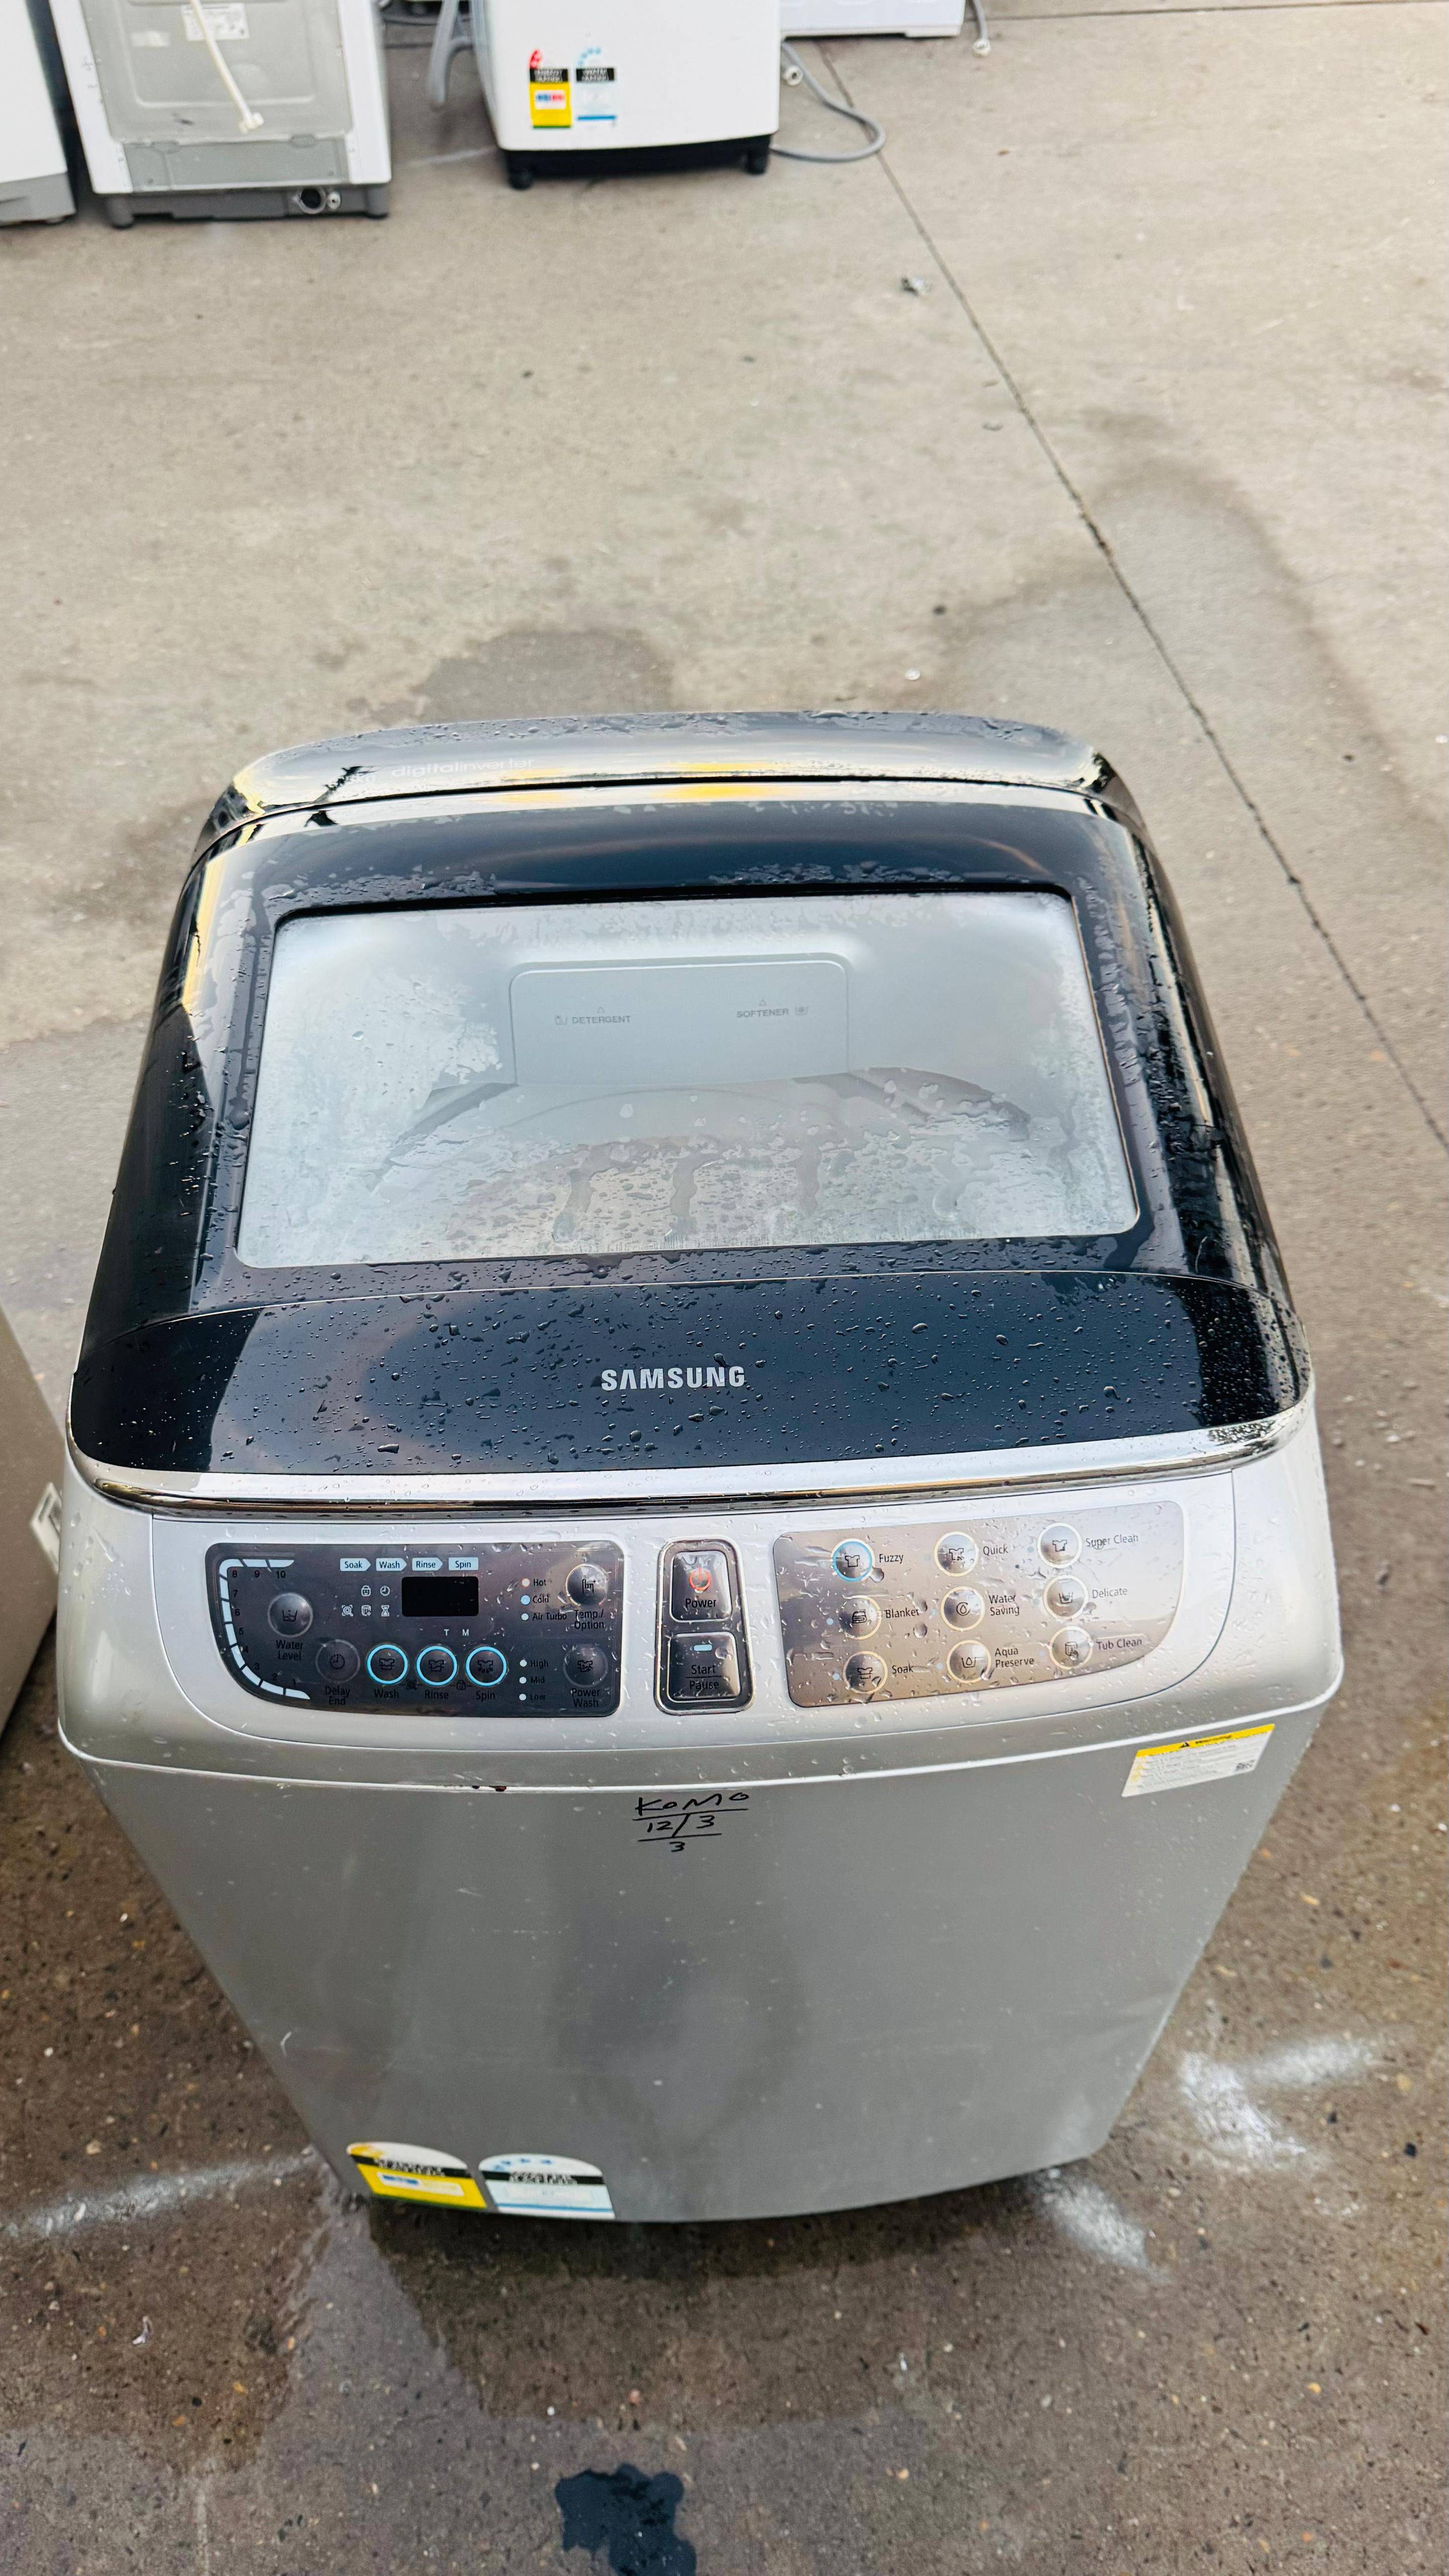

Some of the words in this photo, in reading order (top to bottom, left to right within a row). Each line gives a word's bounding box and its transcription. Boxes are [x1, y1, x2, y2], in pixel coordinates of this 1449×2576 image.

[737, 1008, 789, 1018] SOFTENER
[572, 1016, 631, 1024] DETERGENT
[601, 1366, 745, 1391] SAMSUNG
[1086, 1538, 1111, 1549] Super
[1113, 1534, 1139, 1544] Clean
[983, 1545, 1008, 1556] Quick
[879, 1554, 904, 1564] Fuzzy
[345, 1561, 362, 1569] Soak
[379, 1561, 400, 1569] Wash
[455, 1560, 471, 1569] Spin
[232, 1570, 238, 1578] 8
[254, 1570, 260, 1578] 9
[276, 1570, 286, 1578] 10
[233, 1589, 238, 1598] 7
[1092, 1587, 1128, 1599] Delicate
[532, 1594, 549, 1603] Cold
[685, 1598, 716, 1608] Power
[989, 1594, 1016, 1604] Water
[234, 1608, 240, 1617] 6
[886, 1607, 920, 1619] Blanket
[990, 1606, 1020, 1617] Saving
[546, 1613, 567, 1621] Turbo
[574, 1621, 605, 1631] Option
[276, 1640, 303, 1650] Water
[1097, 1640, 1114, 1651] Tub
[1116, 1638, 1142, 1649] Clean
[278, 1651, 301, 1661] Level
[995, 1647, 1018, 1658] Aqua
[254, 1662, 260, 1670] 3
[530, 1660, 548, 1669] High
[995, 1657, 1034, 1668] Preserve
[691, 1664, 716, 1674] Start
[892, 1664, 914, 1674] Soak
[271, 1672, 278, 1681] 2
[690, 1680, 719, 1690] Pause
[326, 1685, 350, 1697] Delay
[374, 1689, 399, 1699] Wash
[425, 1689, 449, 1700] Rinse
[476, 1690, 496, 1702] Spin
[572, 1688, 600, 1697] Power
[329, 1696, 346, 1706] End
[573, 1698, 599, 1708] Wash
[669, 1841, 686, 1853] 3
